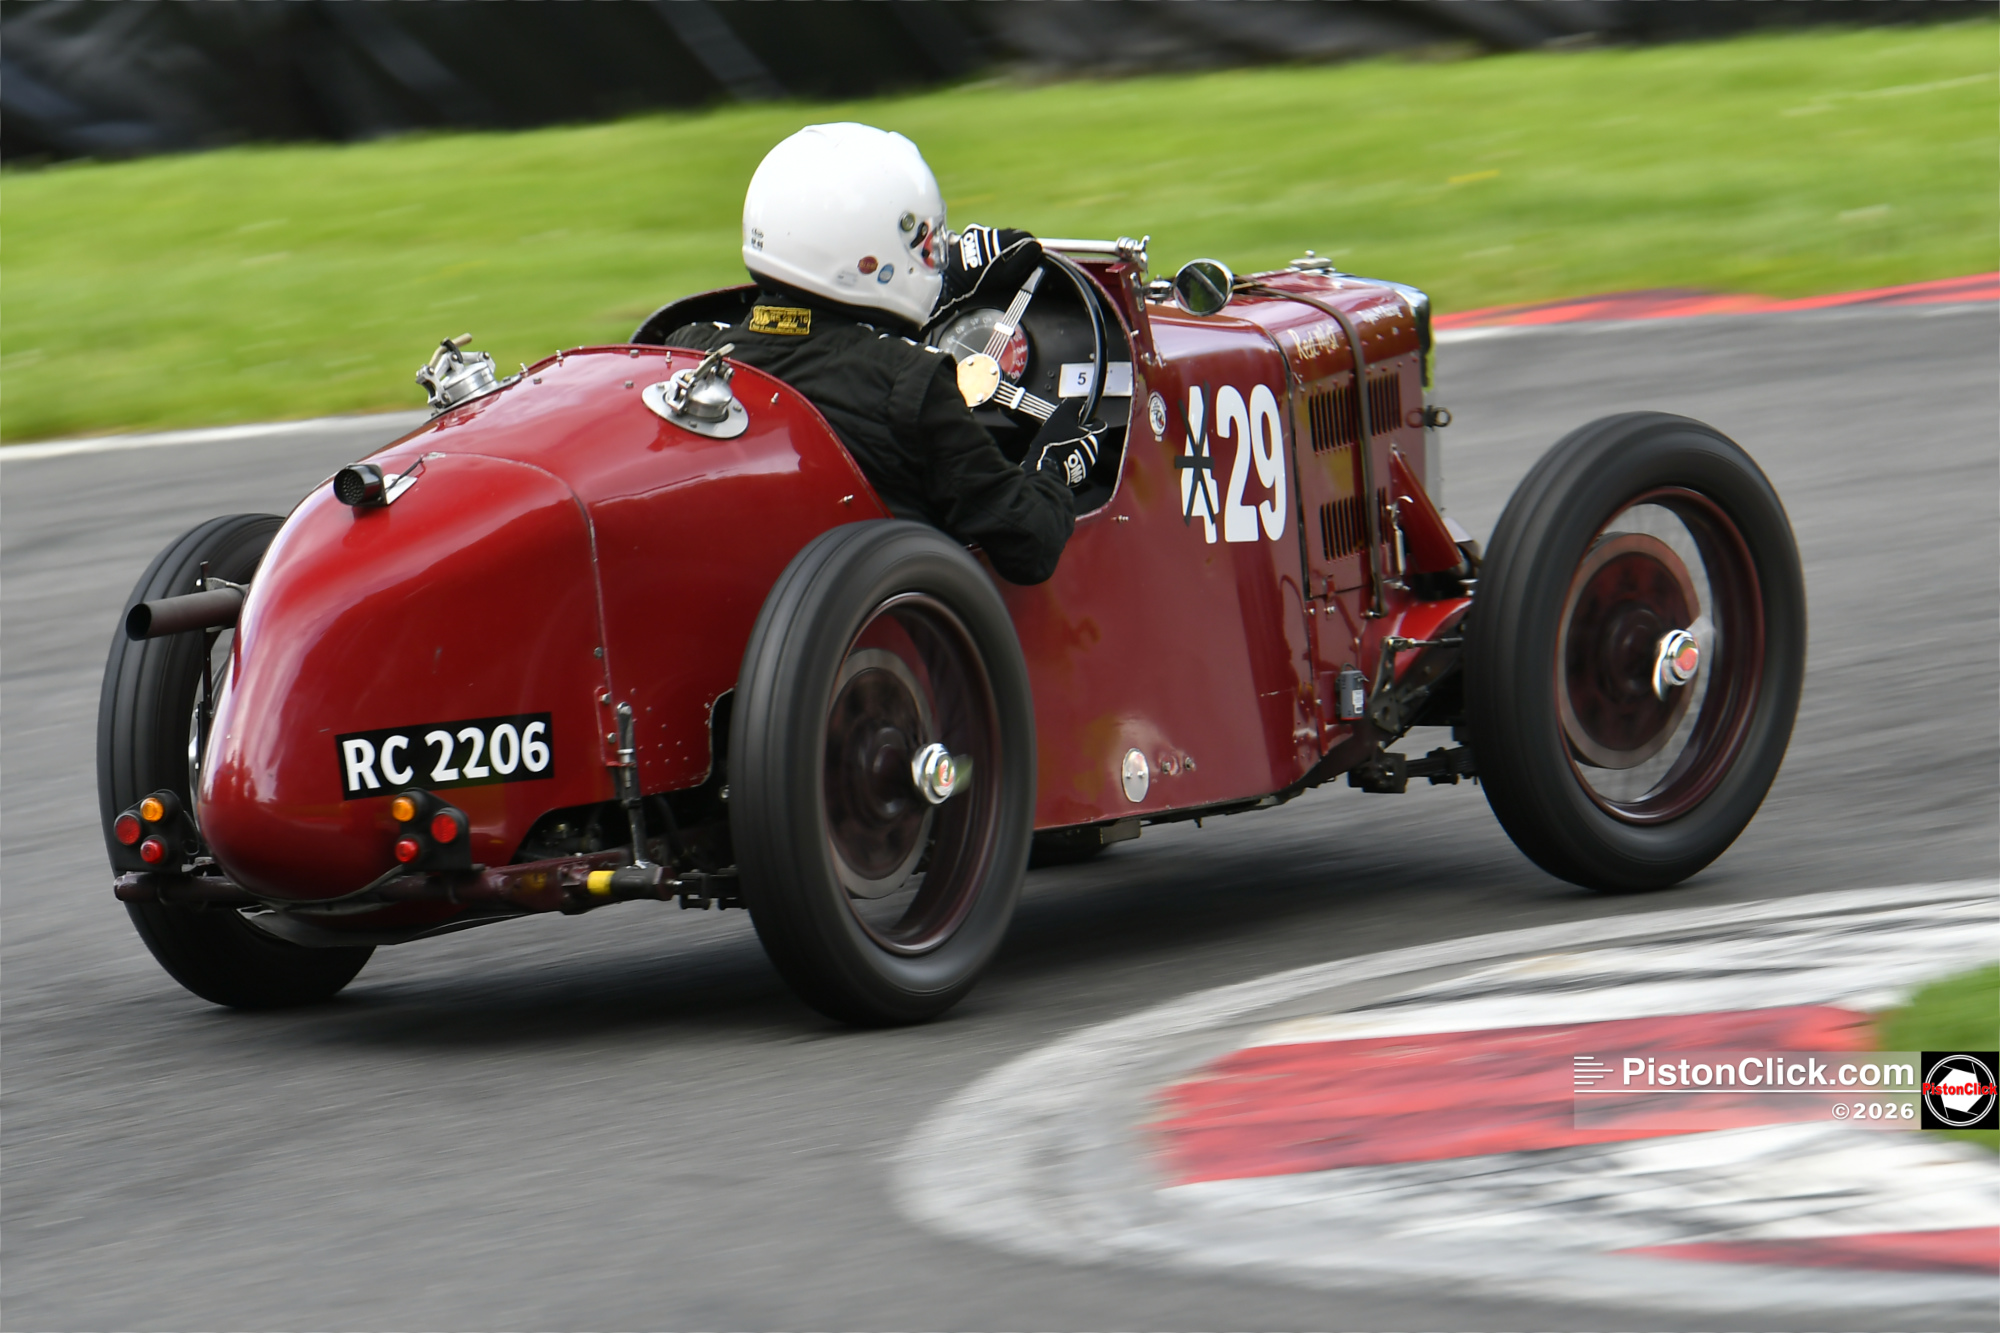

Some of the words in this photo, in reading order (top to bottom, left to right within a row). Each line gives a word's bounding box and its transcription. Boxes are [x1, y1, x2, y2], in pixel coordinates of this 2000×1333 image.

[963, 231, 979, 268] OMP
[1287, 328, 1320, 360] Red
[1077, 372, 1086, 385] 5
[1067, 453, 1083, 484] OMP
[342, 734, 414, 791] RC
[424, 721, 550, 782] 2206
